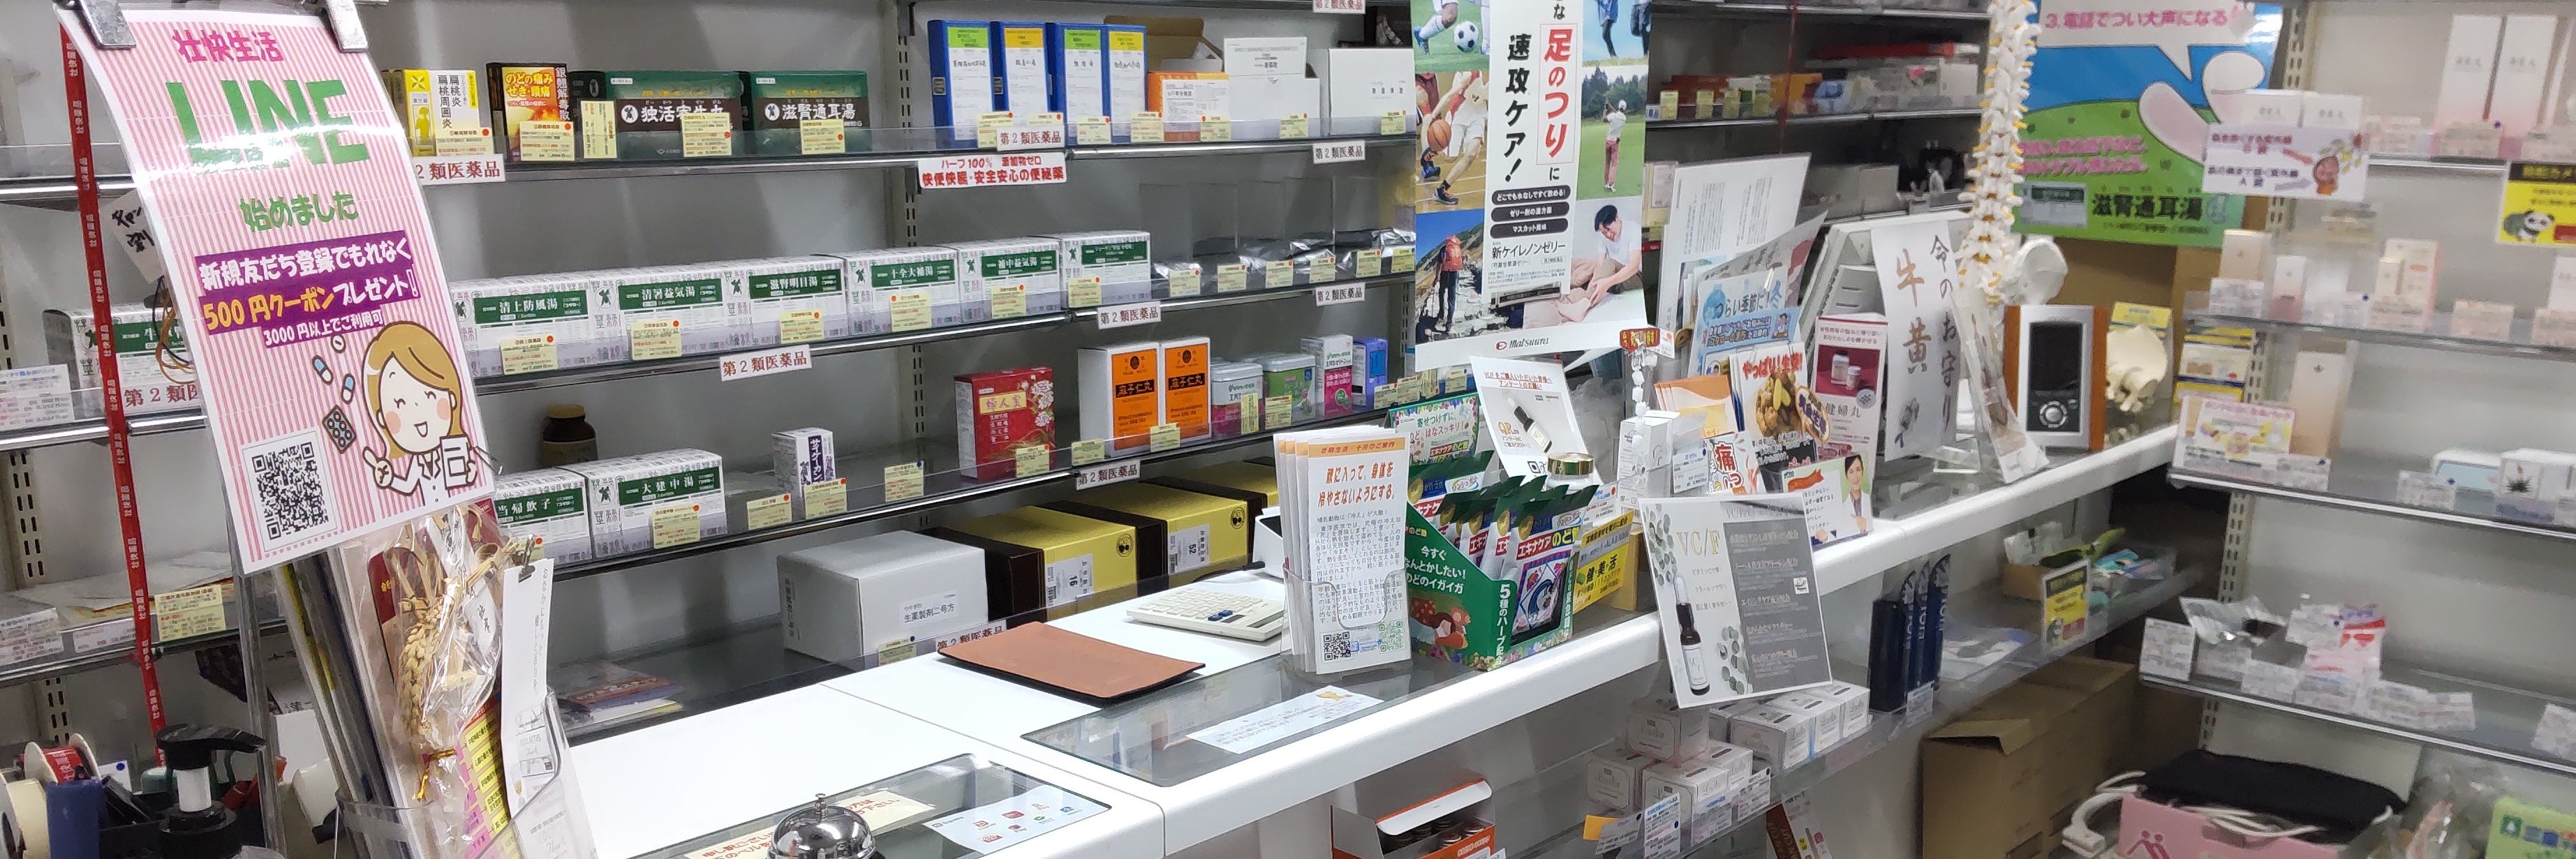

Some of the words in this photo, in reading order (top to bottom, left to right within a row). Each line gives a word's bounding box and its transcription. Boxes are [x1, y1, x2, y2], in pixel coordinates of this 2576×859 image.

[172, 30, 283, 63] 壮快生活
[505, 73, 553, 86] のどの痛み
[1504, 33, 1532, 182] 速攻ケア!
[165, 79, 370, 171] LINE
[1000, 130, 1061, 145] 第2類医薬品
[1316, 147, 1363, 160] 第2類医薬品
[239, 192, 359, 232] 始めました
[199, 237, 412, 290] 新規友だち登録でもれなく
[1317, 286, 1363, 301] 第2類医薬品
[1100, 307, 1158, 325] 第2類医薬品
[723, 351, 807, 377] 第2類医薬品
[1078, 463, 1137, 486] 第2類医薬品
[1421, 546, 1447, 561] 今すぐ
[1407, 573, 1464, 595] のどのイガイガ
[904, 604, 955, 623] 生薬製剤二号方
